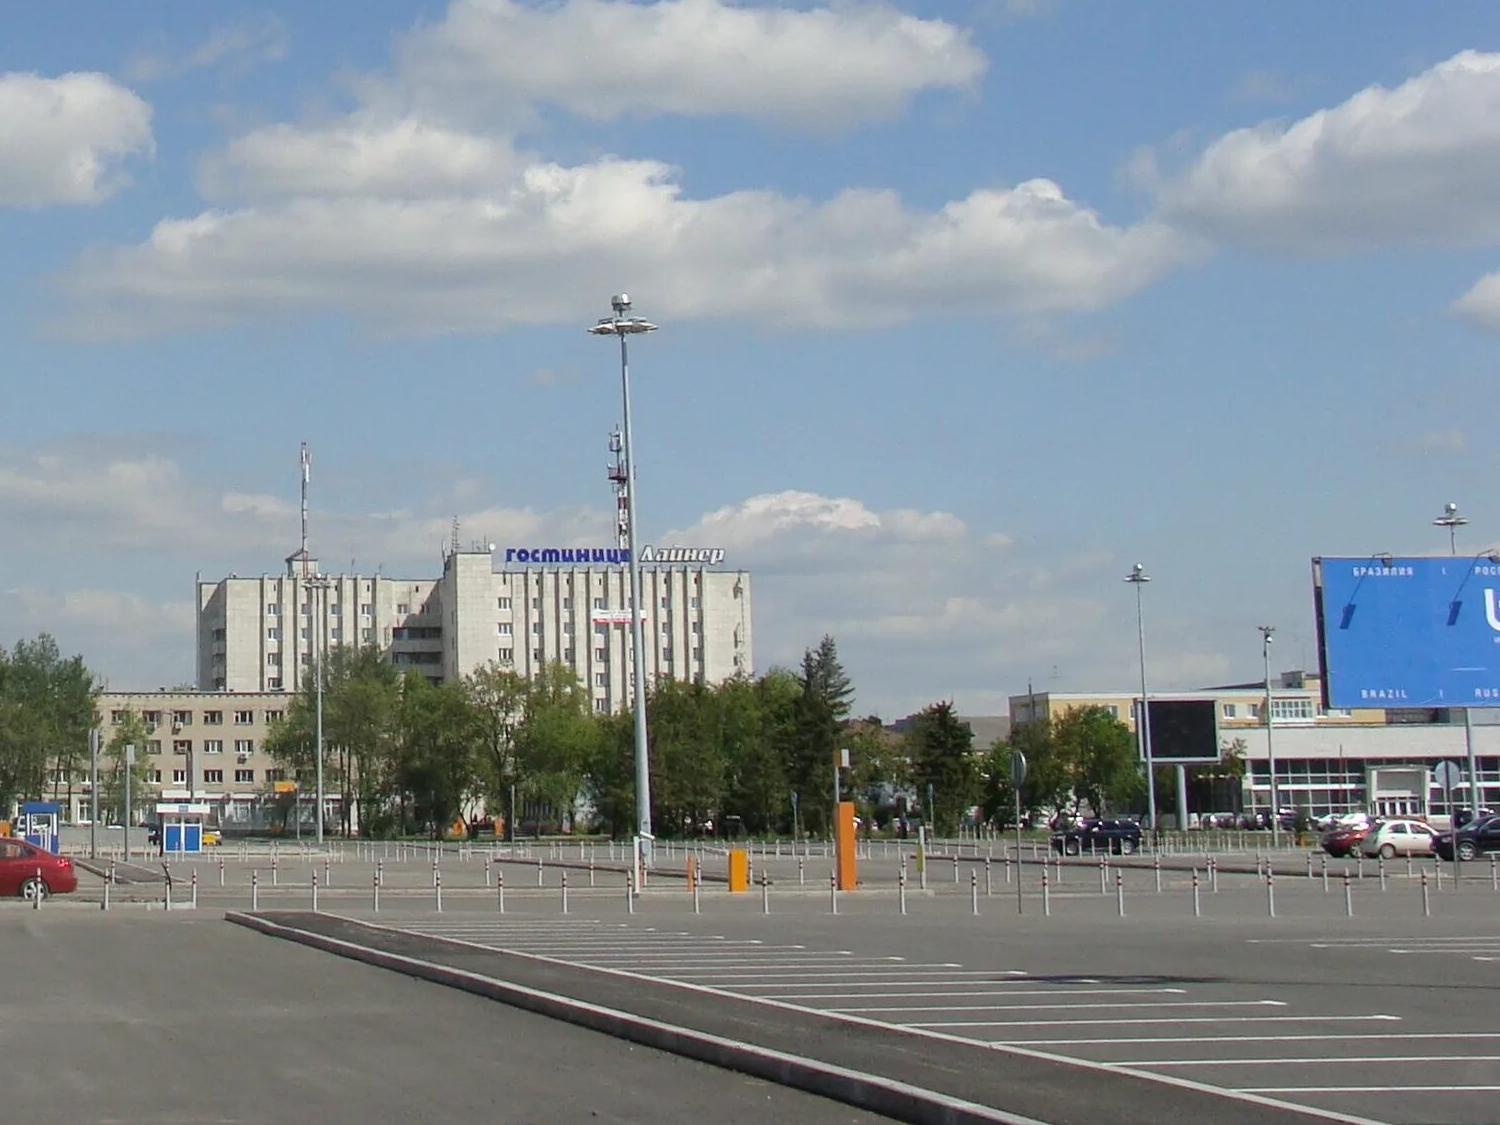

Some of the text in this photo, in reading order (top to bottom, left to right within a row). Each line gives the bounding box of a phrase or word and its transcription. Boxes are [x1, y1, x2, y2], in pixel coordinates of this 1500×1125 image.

[639, 544, 725, 565] Лайнер
[1353, 567, 1413, 577] БРАЗИЛИЯ
[1361, 689, 1408, 699] BRAZIL
